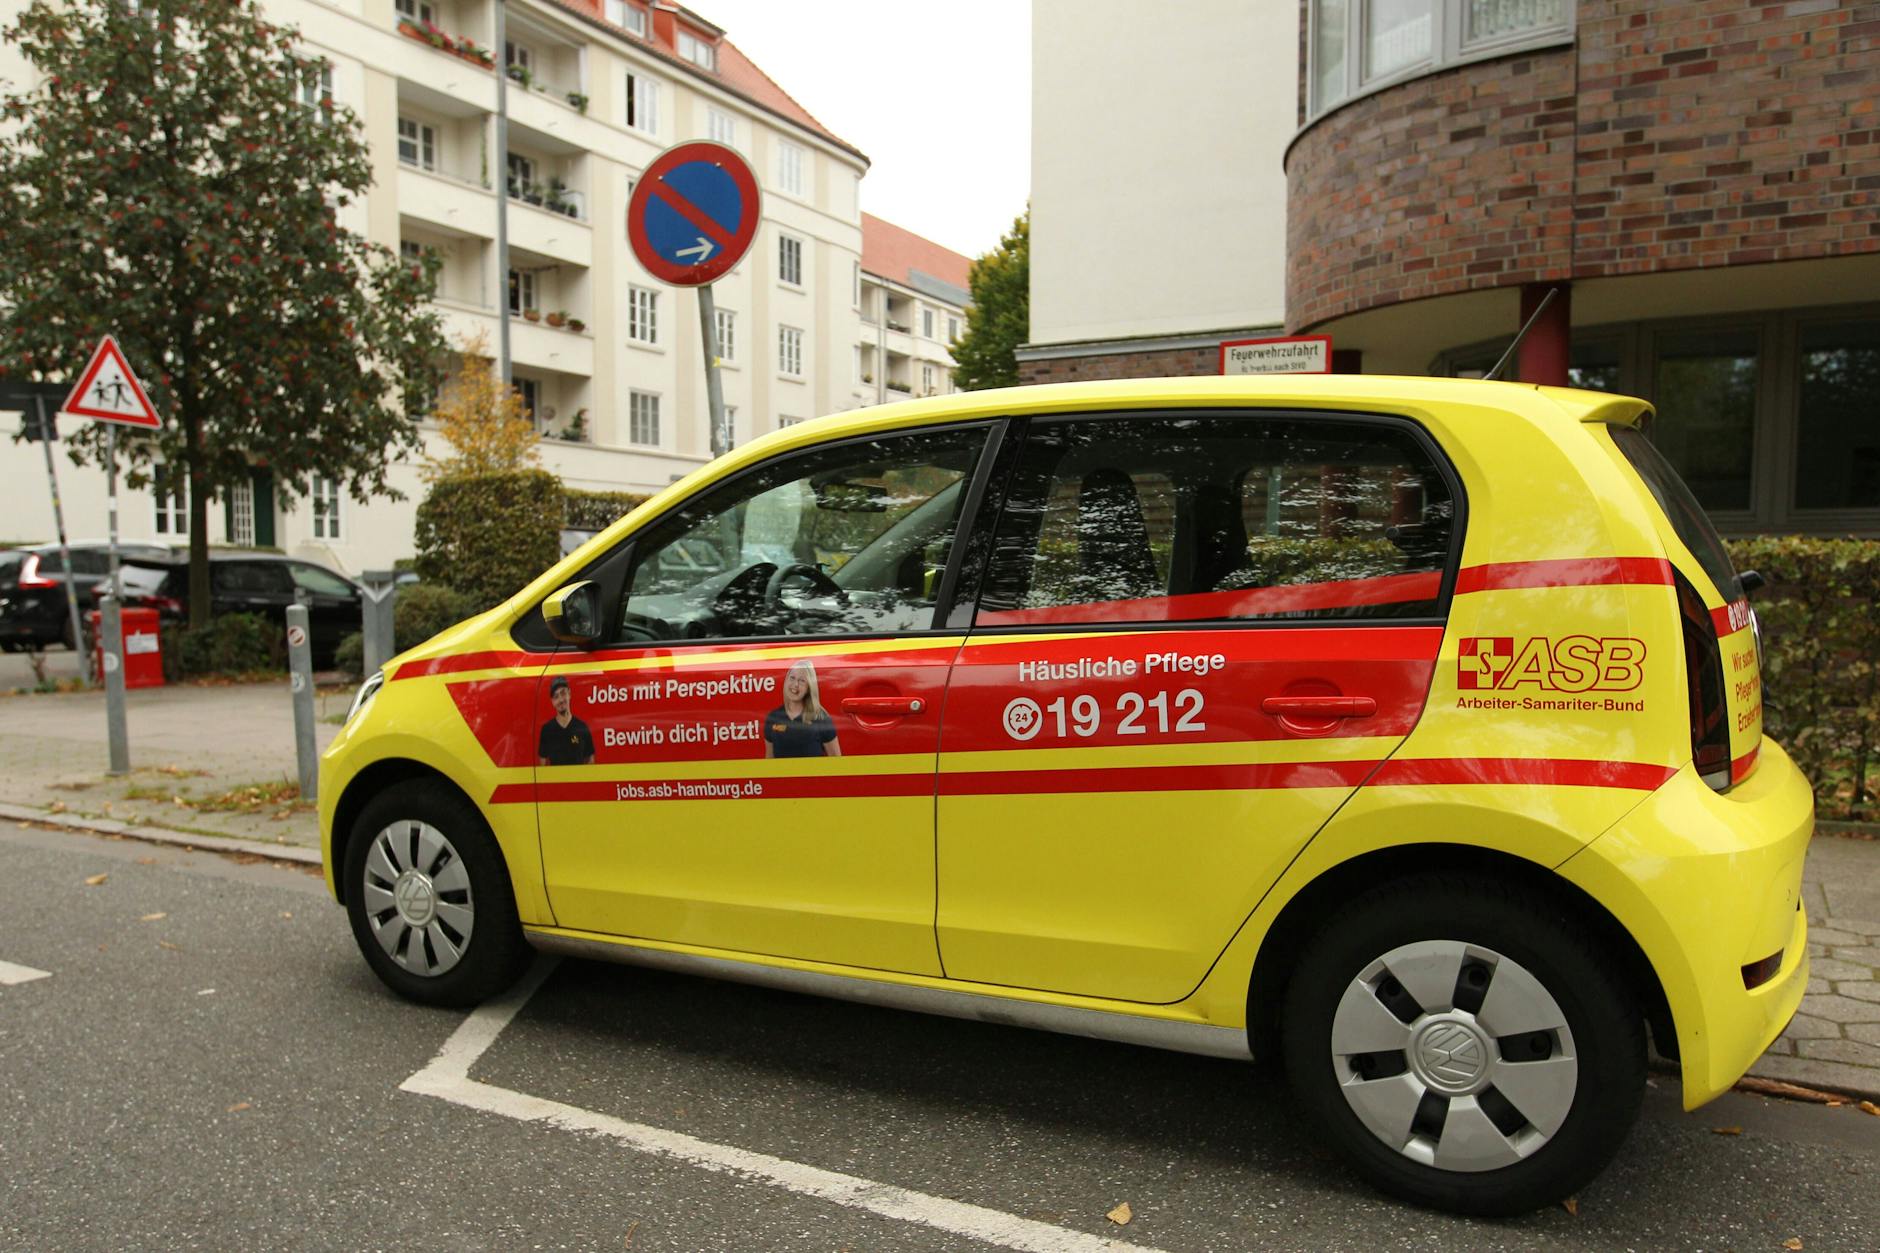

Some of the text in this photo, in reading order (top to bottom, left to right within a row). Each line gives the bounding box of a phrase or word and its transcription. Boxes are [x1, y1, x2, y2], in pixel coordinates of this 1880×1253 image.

[1231, 344, 1318, 361] Feuerwehrzufahrt
[1018, 652, 1226, 682] Häusliche Pflege
[1497, 635, 1647, 694] ASB
[587, 673, 776, 704] Jobs mit Perspektive
[1015, 688, 1206, 738] 24 19 212
[1456, 697, 1645, 712] Arbeiter-Samariter-Bund
[603, 719, 760, 747] Bewirb dich jetzt!
[616, 780, 763, 801] jobs.asb-hamburg.de
